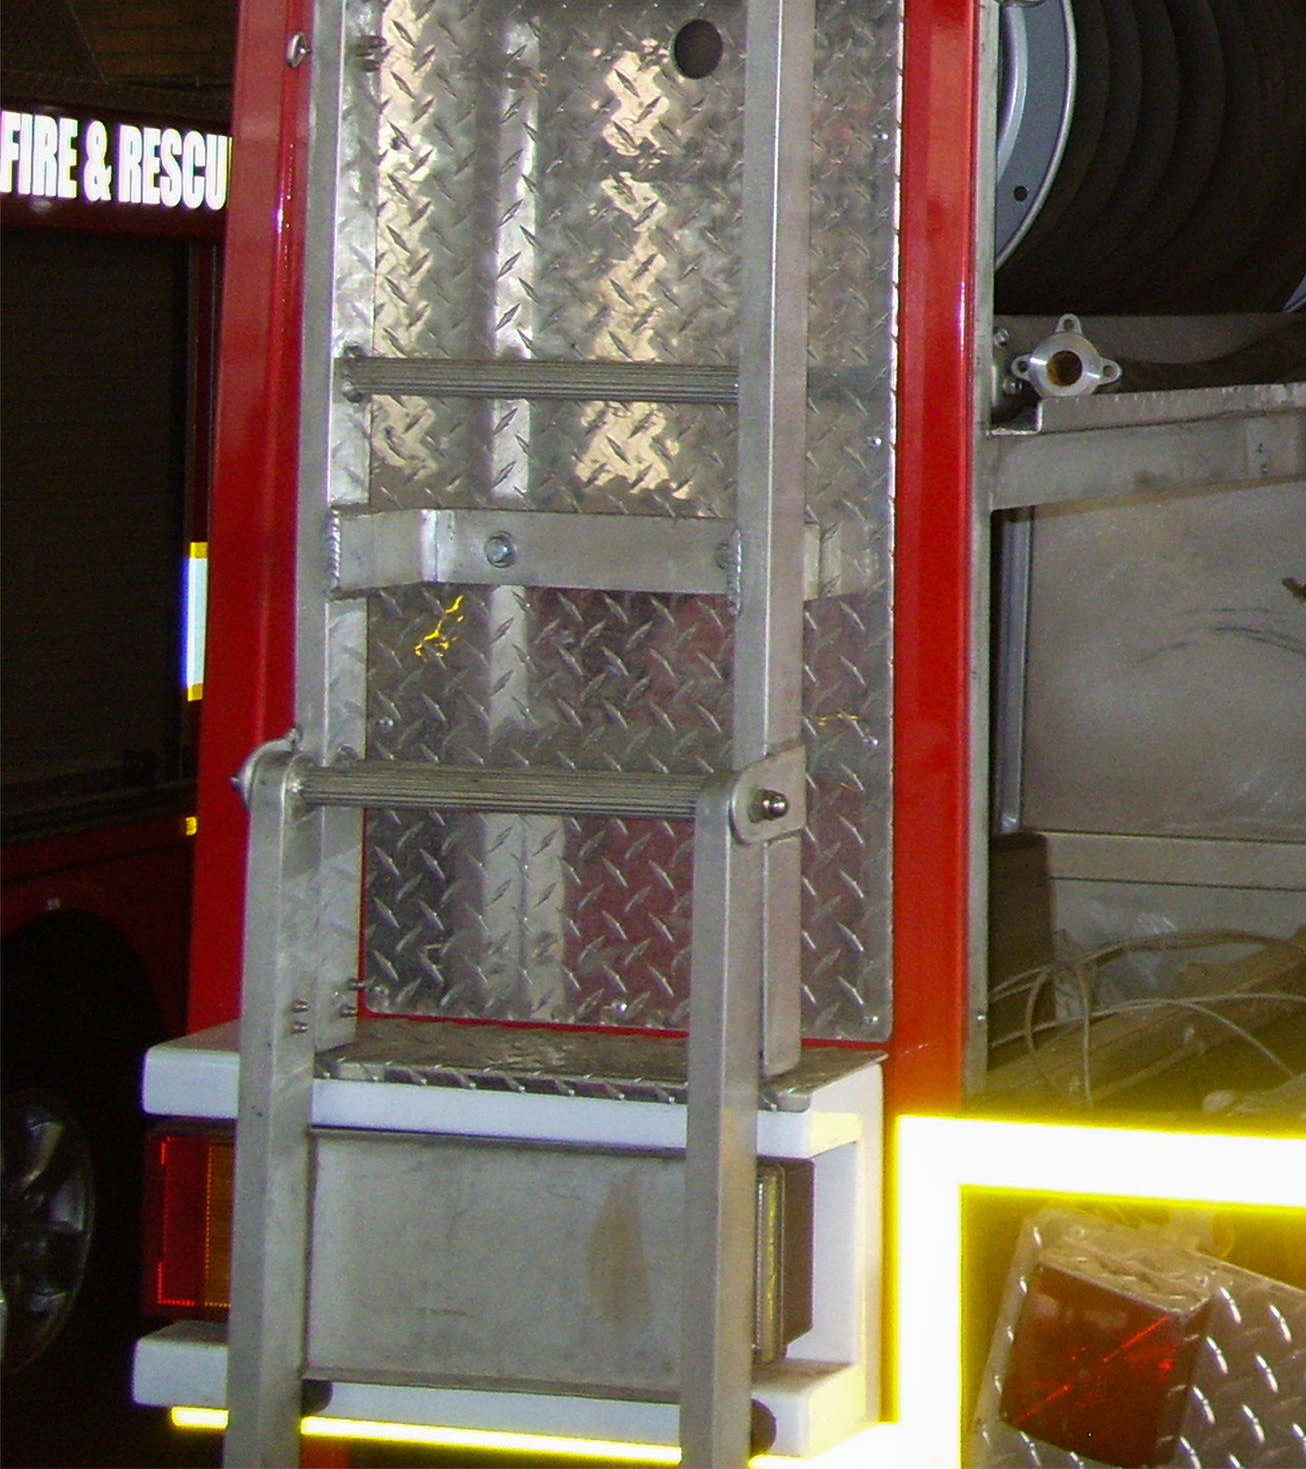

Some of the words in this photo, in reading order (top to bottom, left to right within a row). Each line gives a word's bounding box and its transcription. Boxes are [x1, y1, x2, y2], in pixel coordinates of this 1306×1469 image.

[0, 109, 78, 199] FIRE
[84, 120, 112, 202] &
[118, 123, 232, 211] RESCU
